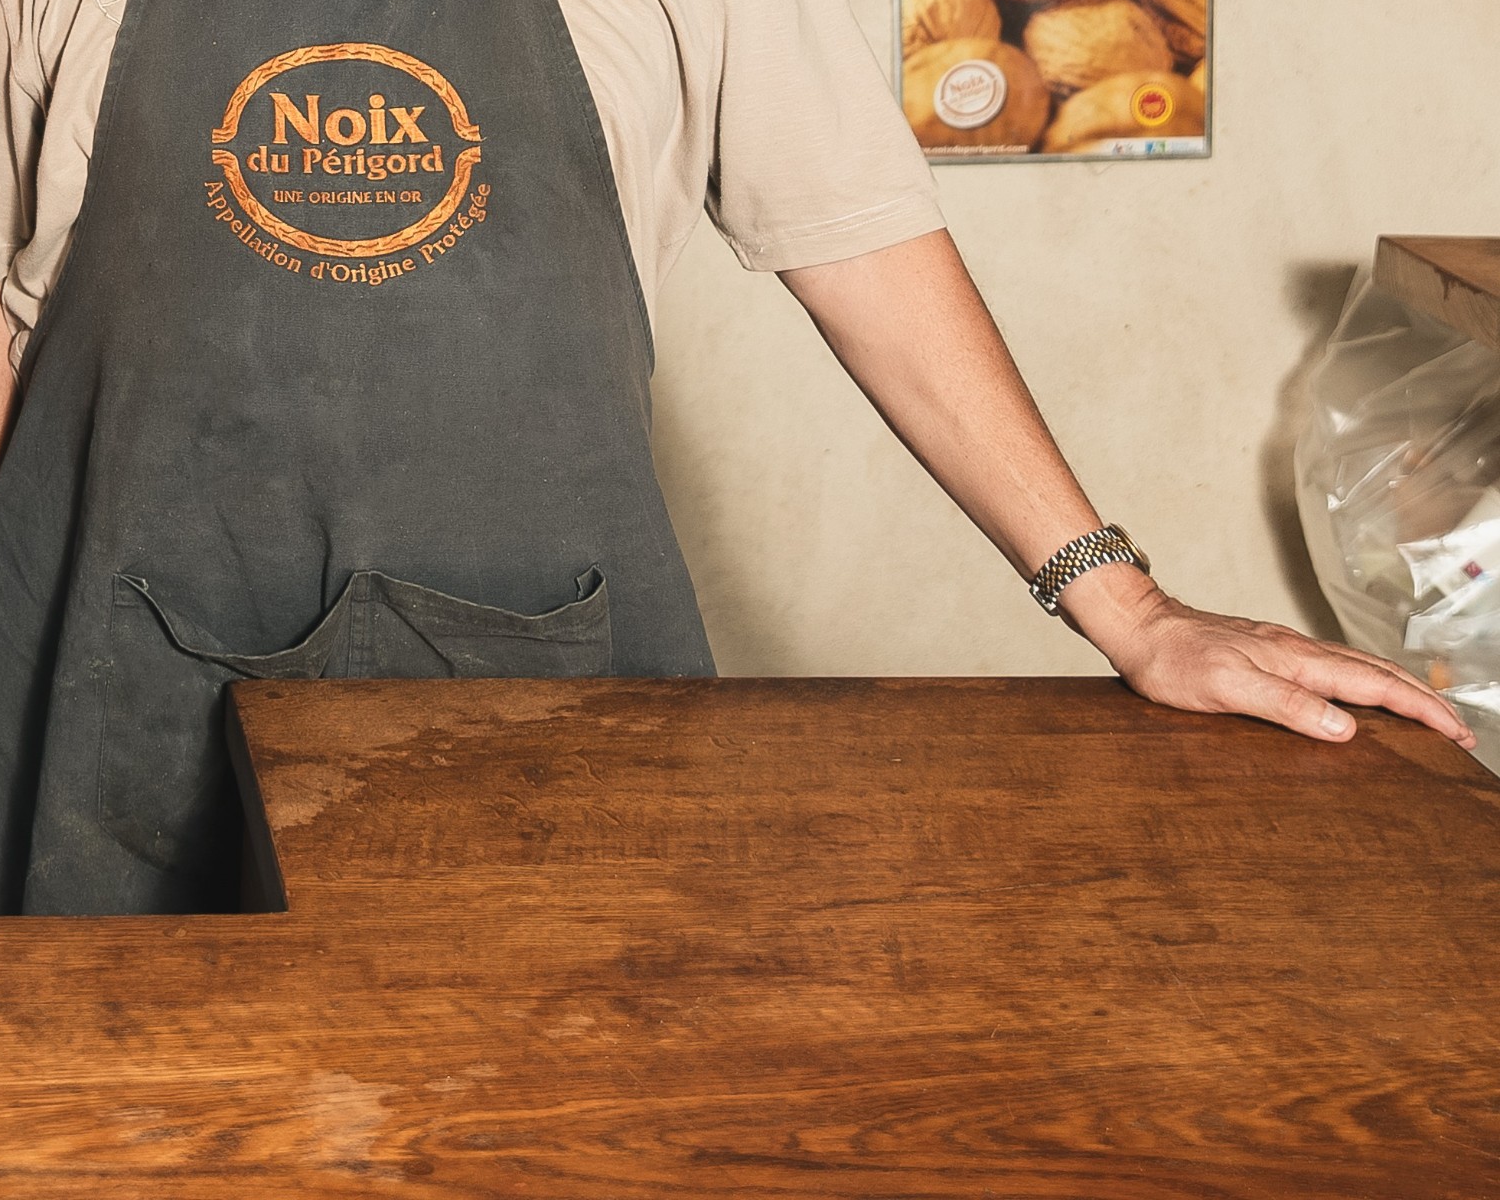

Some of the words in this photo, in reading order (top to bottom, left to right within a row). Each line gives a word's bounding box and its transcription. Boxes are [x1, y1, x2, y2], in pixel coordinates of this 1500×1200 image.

[269, 92, 429, 146] Noix
[246, 146, 290, 174] du
[302, 145, 444, 181] Périgord
[922, 145, 1028, 155] w.noixduperigord.com
[273, 190, 305, 203] UNE
[308, 191, 373, 204] ORIGINE
[375, 191, 396, 204] EN
[400, 190, 422, 203] OR
[204, 180, 303, 274] Appellation
[310, 257, 417, 287] d'Origine
[418, 182, 492, 265] Protégée
